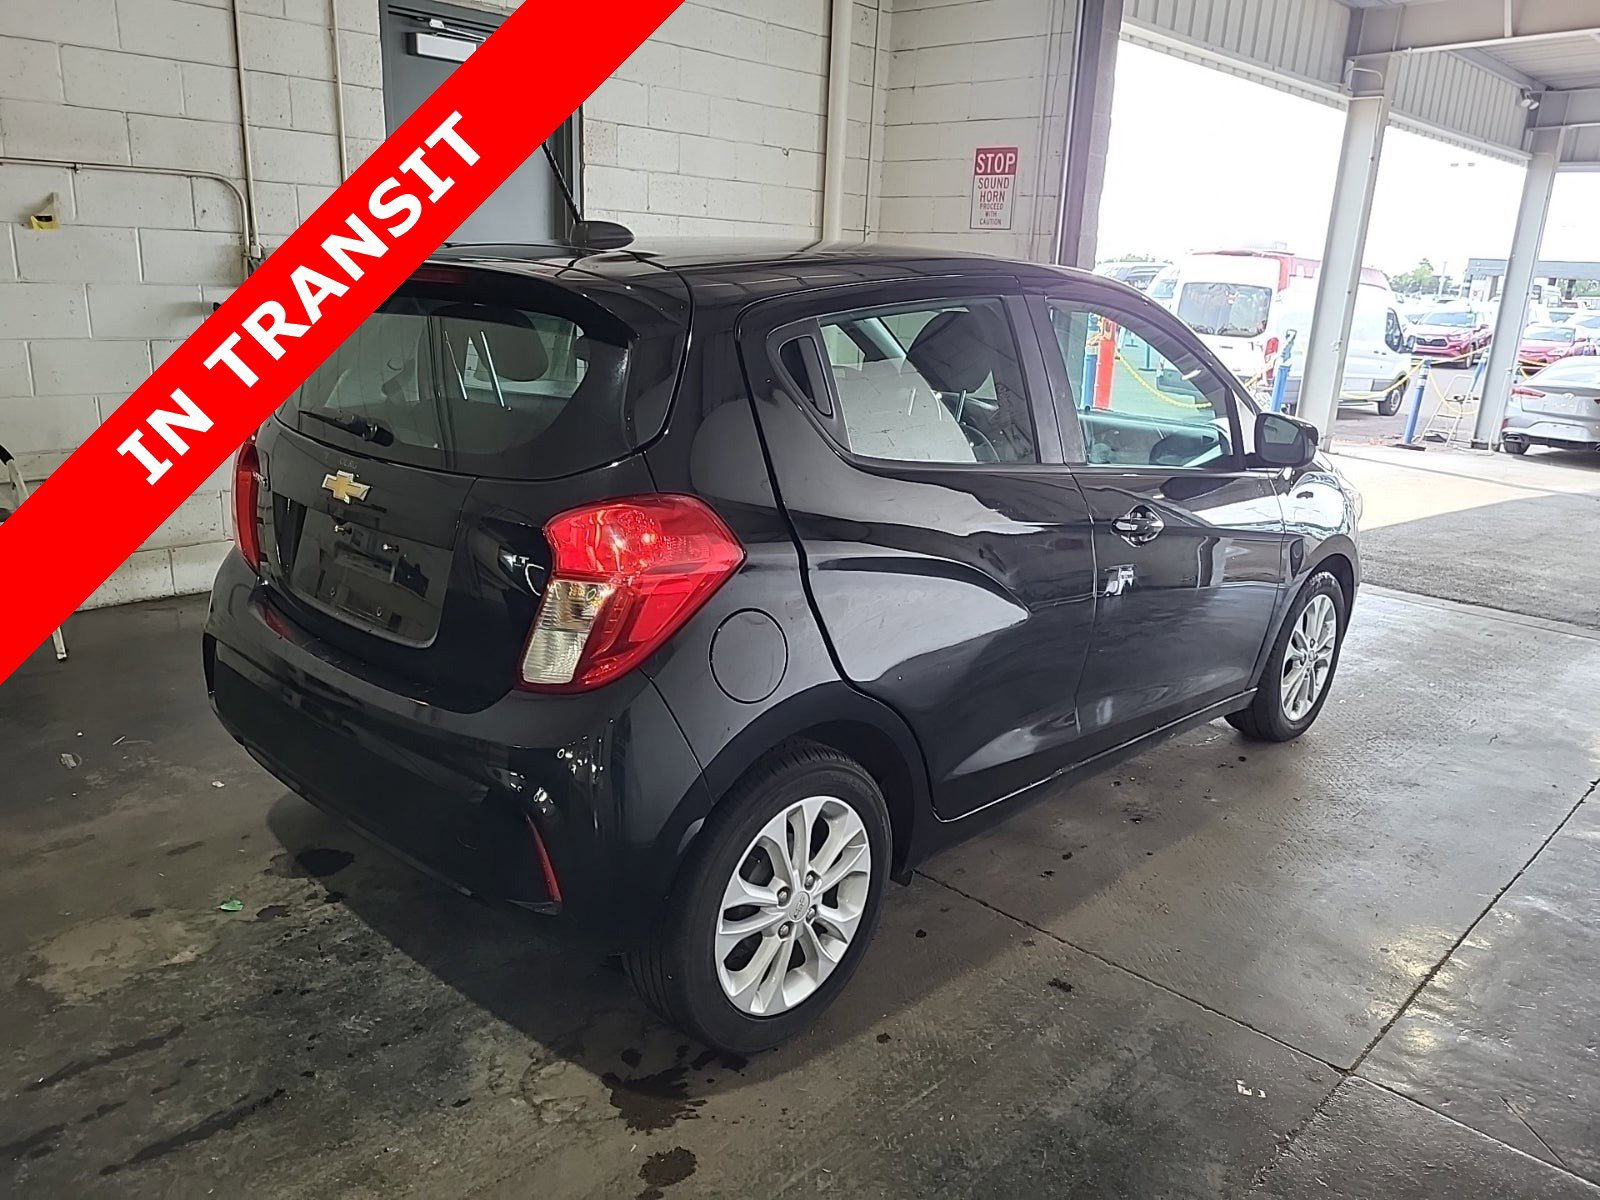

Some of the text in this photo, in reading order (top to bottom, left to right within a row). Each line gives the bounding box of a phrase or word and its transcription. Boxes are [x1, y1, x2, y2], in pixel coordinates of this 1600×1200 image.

[976, 152, 1016, 174] STOP
[978, 177, 1010, 189] SOUND
[979, 190, 1006, 203] HORN
[980, 202, 1004, 210] PROCEED
